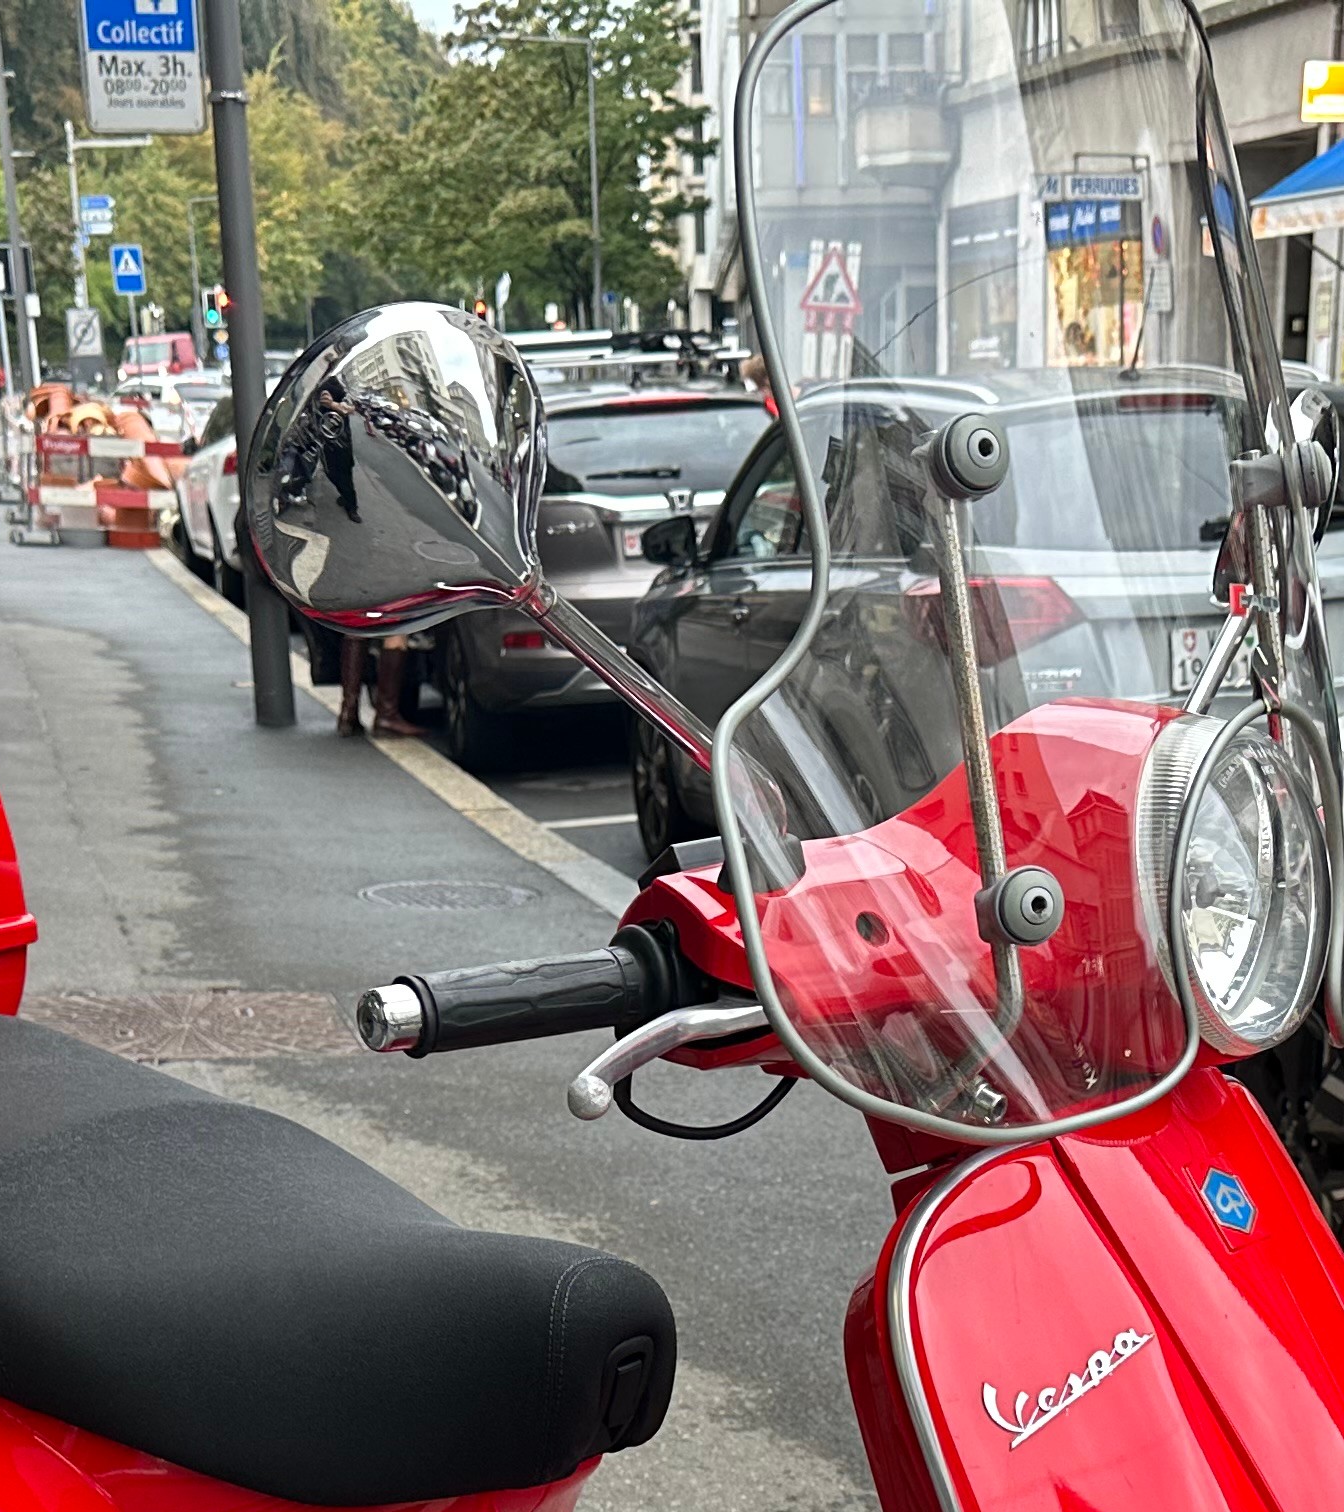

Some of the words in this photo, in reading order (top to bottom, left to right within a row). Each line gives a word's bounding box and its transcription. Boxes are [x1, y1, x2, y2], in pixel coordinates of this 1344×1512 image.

[97, 20, 184, 45] Collectif
[98, 54, 152, 77] Max.
[158, 54, 193, 78] 3h.
[982, 1328, 1155, 1451] Vespa
